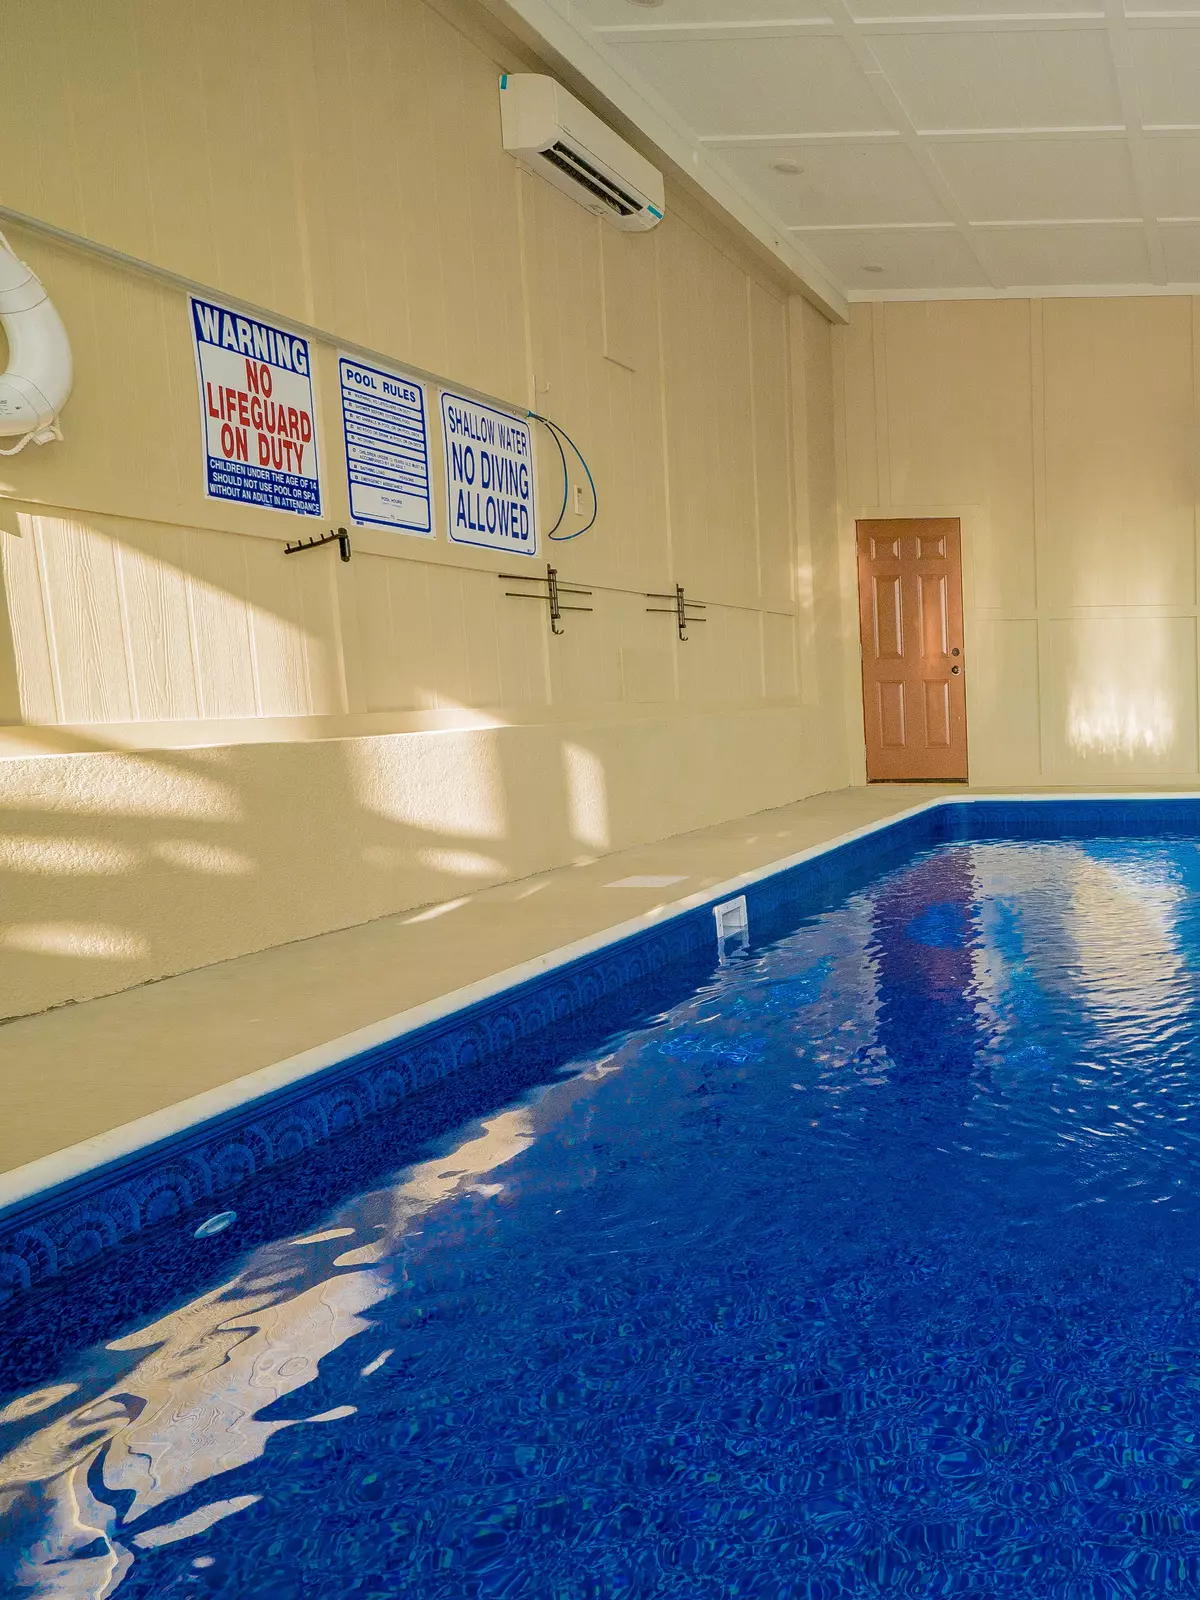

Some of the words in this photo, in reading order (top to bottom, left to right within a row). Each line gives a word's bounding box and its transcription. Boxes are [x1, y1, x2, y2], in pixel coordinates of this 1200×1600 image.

[195, 304, 308, 375] WARNING
[245, 359, 272, 398] NO
[346, 368, 377, 390] POOL
[383, 382, 416, 402] RULES
[207, 382, 312, 443] LIFEGUARD
[448, 406, 494, 446] SHALLOW
[498, 423, 528, 456] WATER
[221, 423, 248, 462] ON
[258, 432, 304, 475] DUTY
[452, 442, 475, 486] NO
[481, 450, 529, 500] DIVING
[209, 483, 240, 498] WITHOUT
[242, 490, 252, 500] AN
[252, 492, 272, 504] ADULT
[274, 496, 280, 505] IN
[282, 498, 320, 512] ATTENDANCE
[210, 459, 245, 475] CHILDREN
[247, 467, 270, 480] UNDER
[272, 472, 284, 484] THE
[286, 476, 298, 486] AGE
[300, 479, 308, 488] OF
[310, 482, 316, 490] 14
[212, 472, 242, 486] SHOULD
[244, 478, 258, 489] NOT
[259, 482, 272, 492] USE
[274, 485, 292, 496] POOL
[292, 488, 302, 498] OR
[303, 491, 316, 501] SPA
[457, 489, 529, 540] ALLOWED
